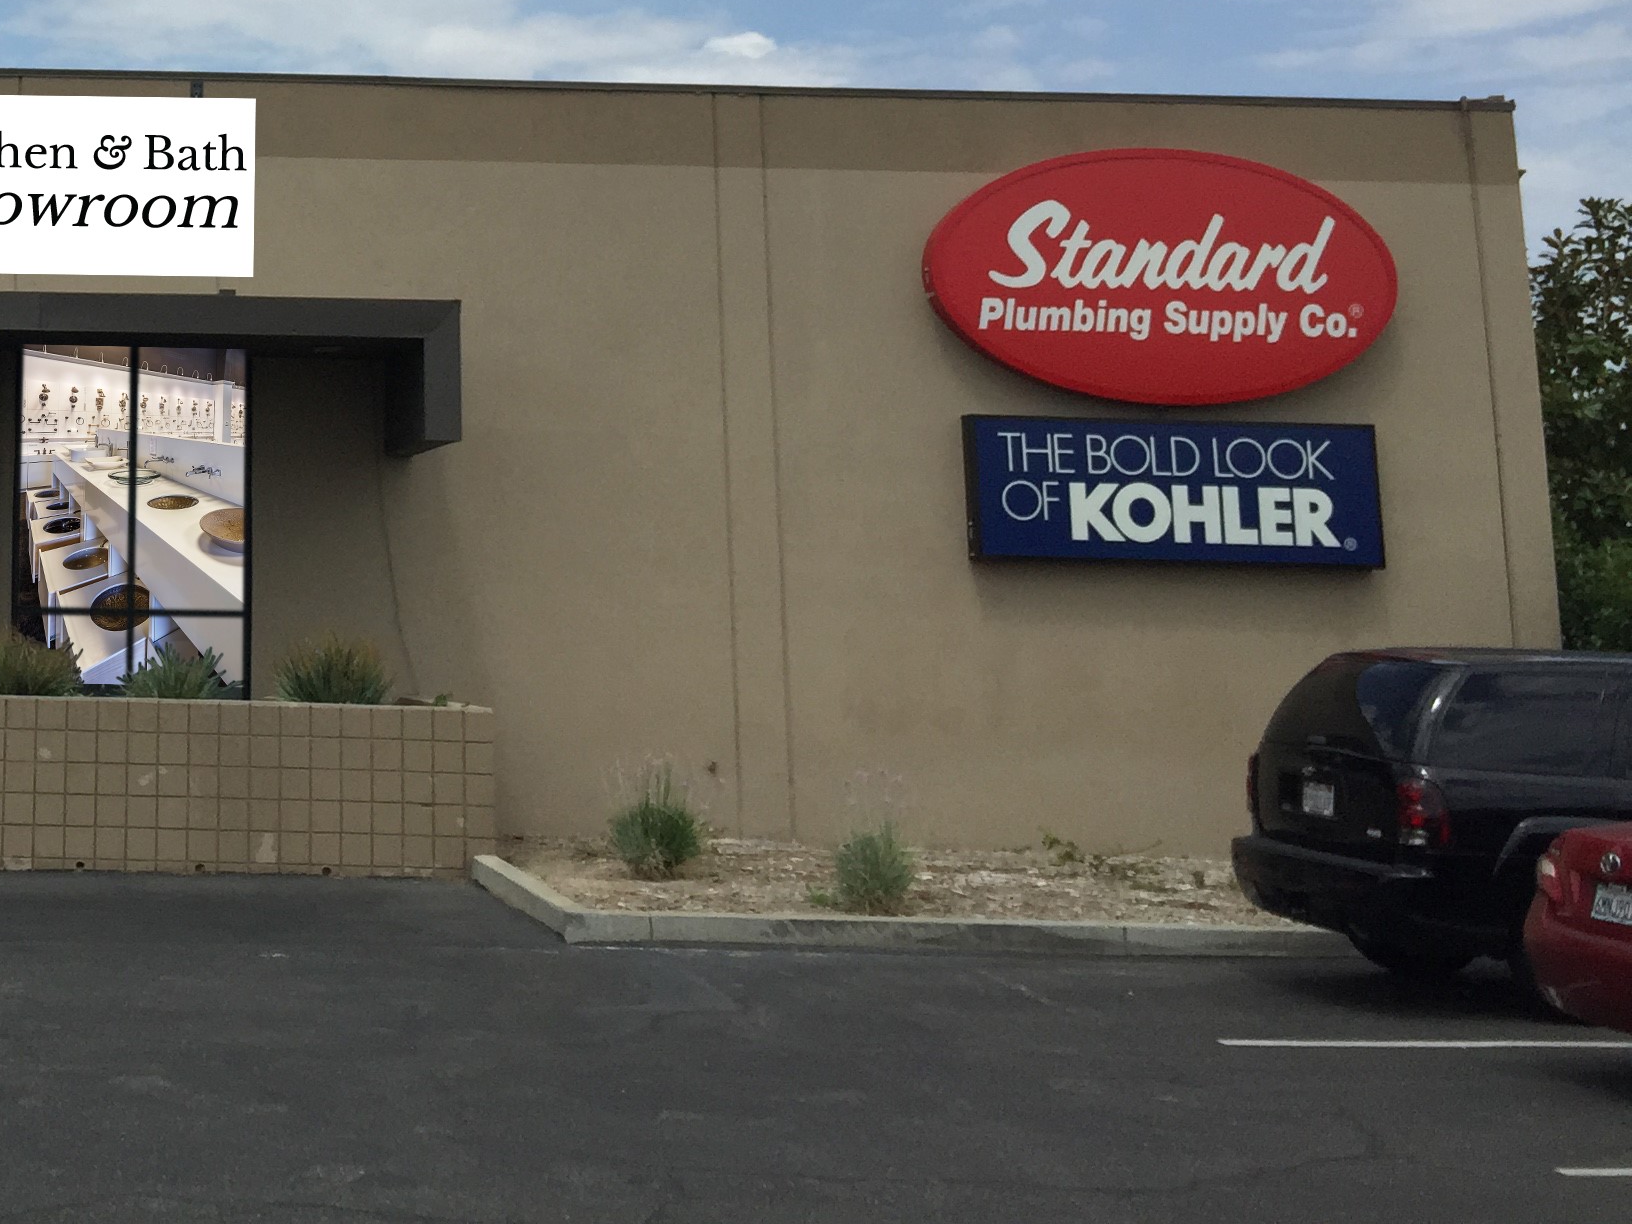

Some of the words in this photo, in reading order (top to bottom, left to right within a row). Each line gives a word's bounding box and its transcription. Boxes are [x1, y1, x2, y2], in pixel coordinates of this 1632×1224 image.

[94, 135, 132, 170] &
[144, 134, 247, 171] Bath
[989, 200, 1335, 294] Standard
[979, 298, 1151, 340] Plumbing
[1164, 301, 1287, 343] Supply
[998, 432, 1075, 473] THE
[1086, 435, 1200, 476] BOLD
[1212, 438, 1334, 479] LOOK
[1002, 480, 1059, 520] OF
[1069, 482, 1341, 547] KOHLER
